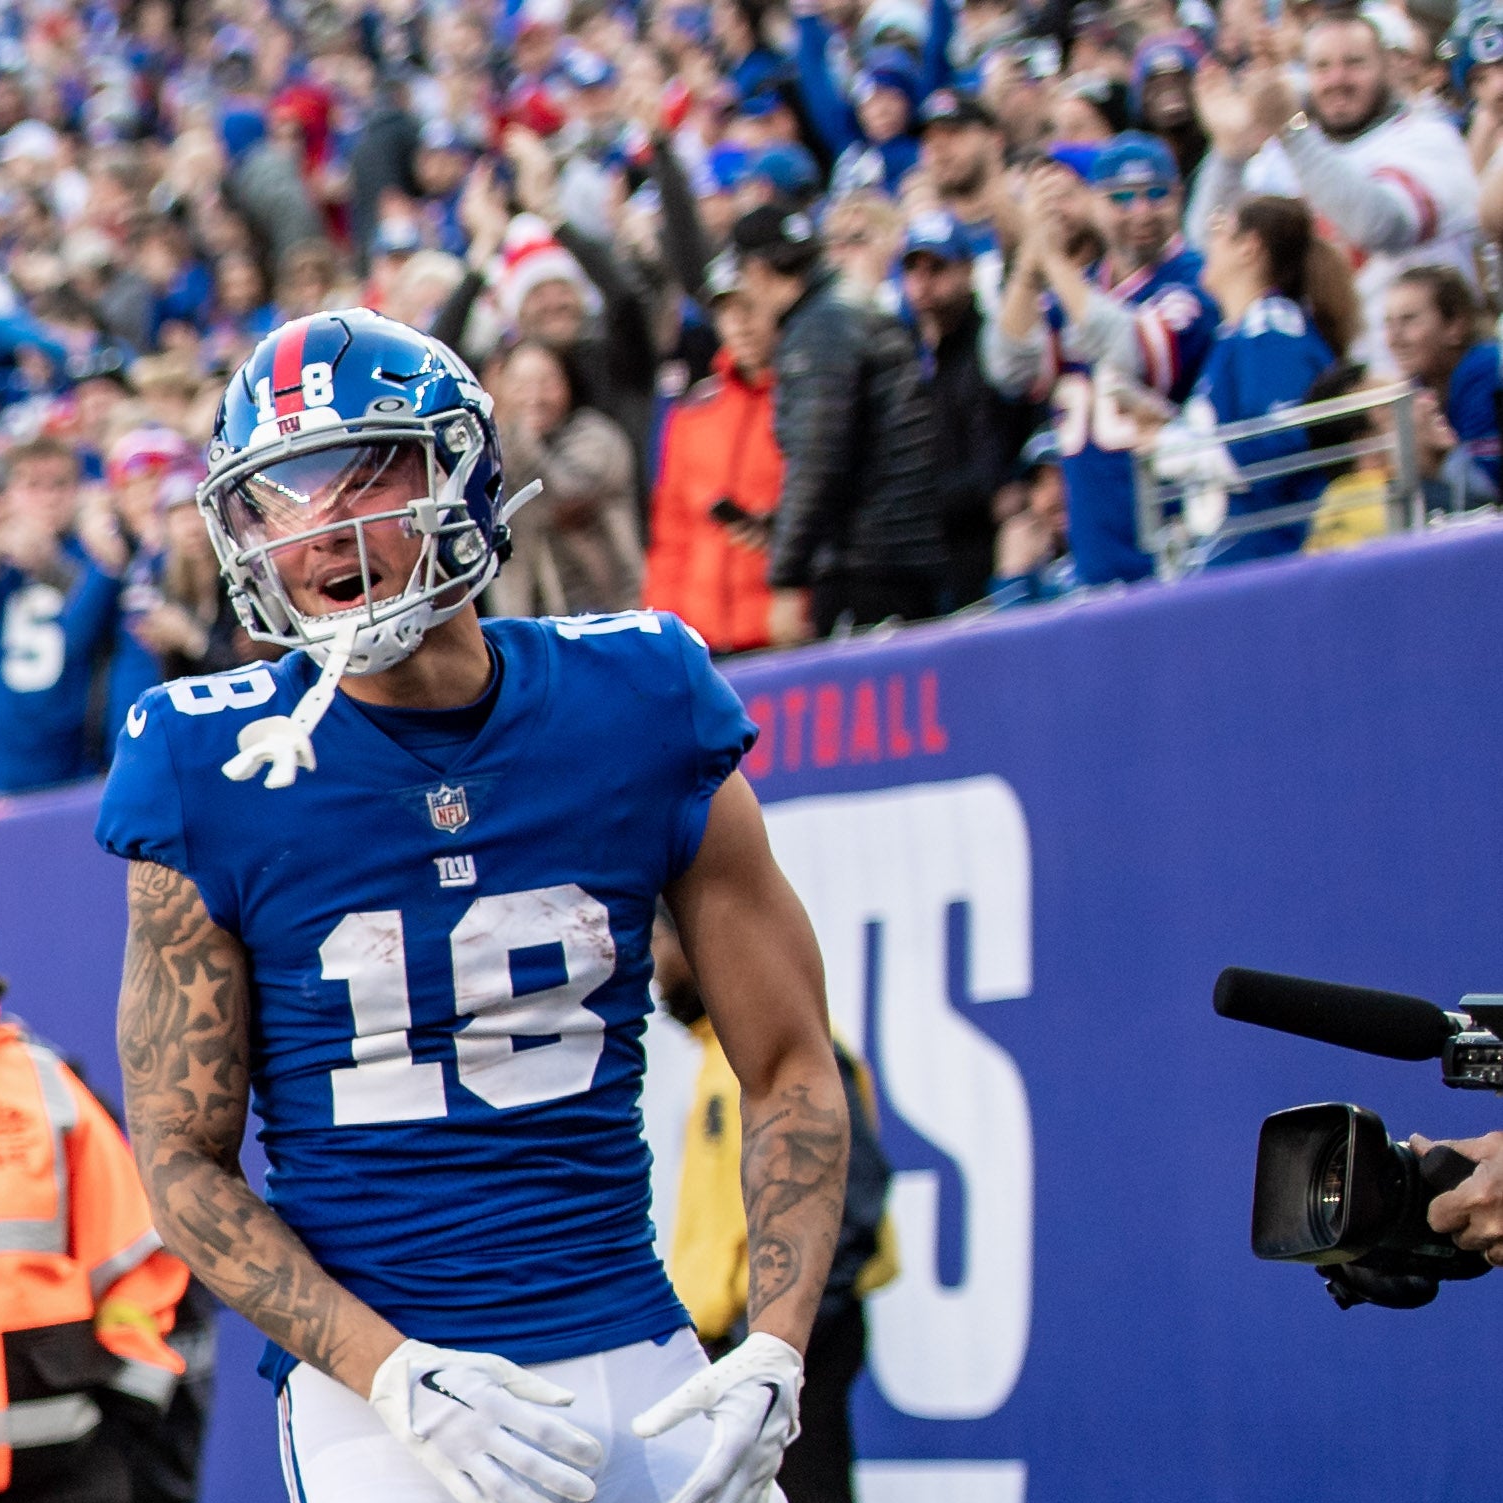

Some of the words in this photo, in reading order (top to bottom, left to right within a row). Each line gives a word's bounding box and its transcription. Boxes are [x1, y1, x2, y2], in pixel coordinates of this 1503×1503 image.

[255, 362, 335, 424] 18
[746, 668, 948, 779] OTBALL
[318, 883, 616, 1127] 18
